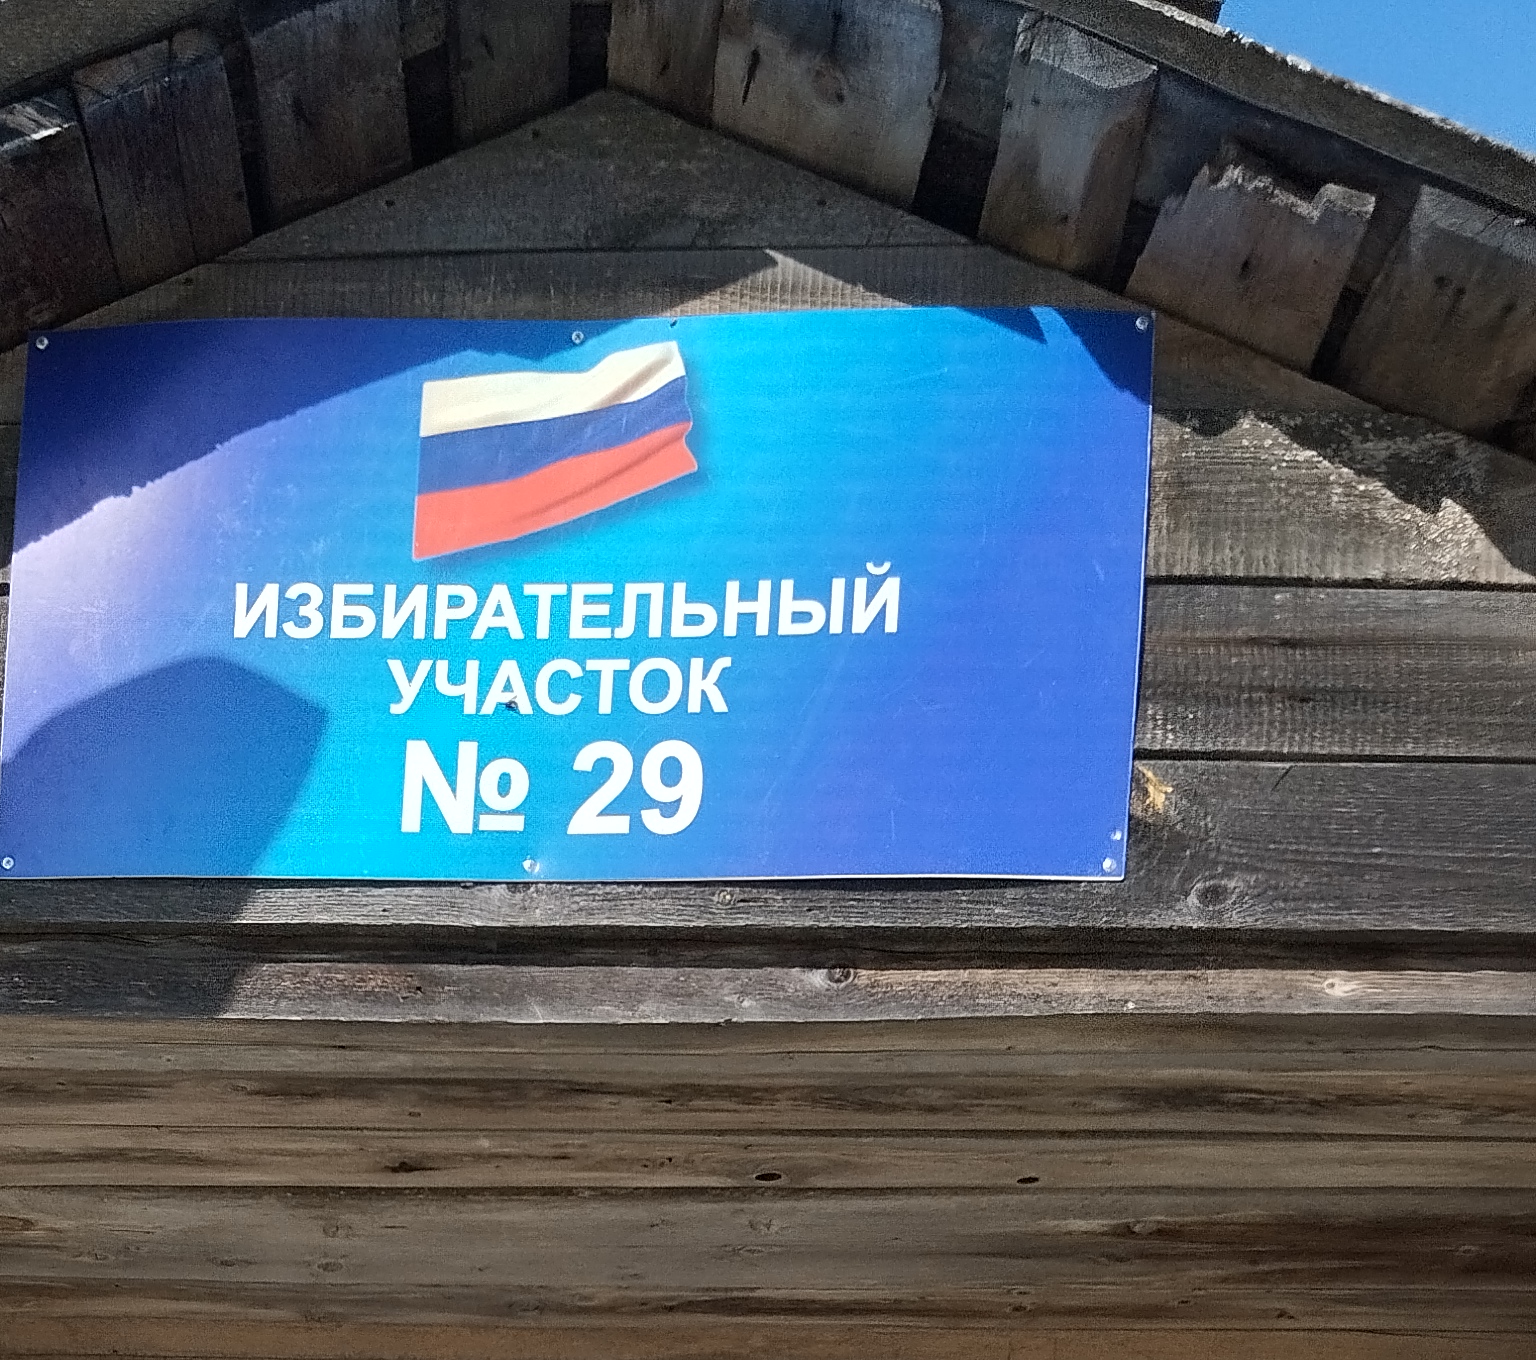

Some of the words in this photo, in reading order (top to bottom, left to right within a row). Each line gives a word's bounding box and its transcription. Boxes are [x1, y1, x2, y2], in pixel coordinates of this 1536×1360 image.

[232, 562, 902, 641] ИЗБИРАТЕЛЬНЫЙ
[386, 656, 732, 716] УЧАСТОК
[400, 739, 530, 835] №
[566, 739, 704, 835] 29
